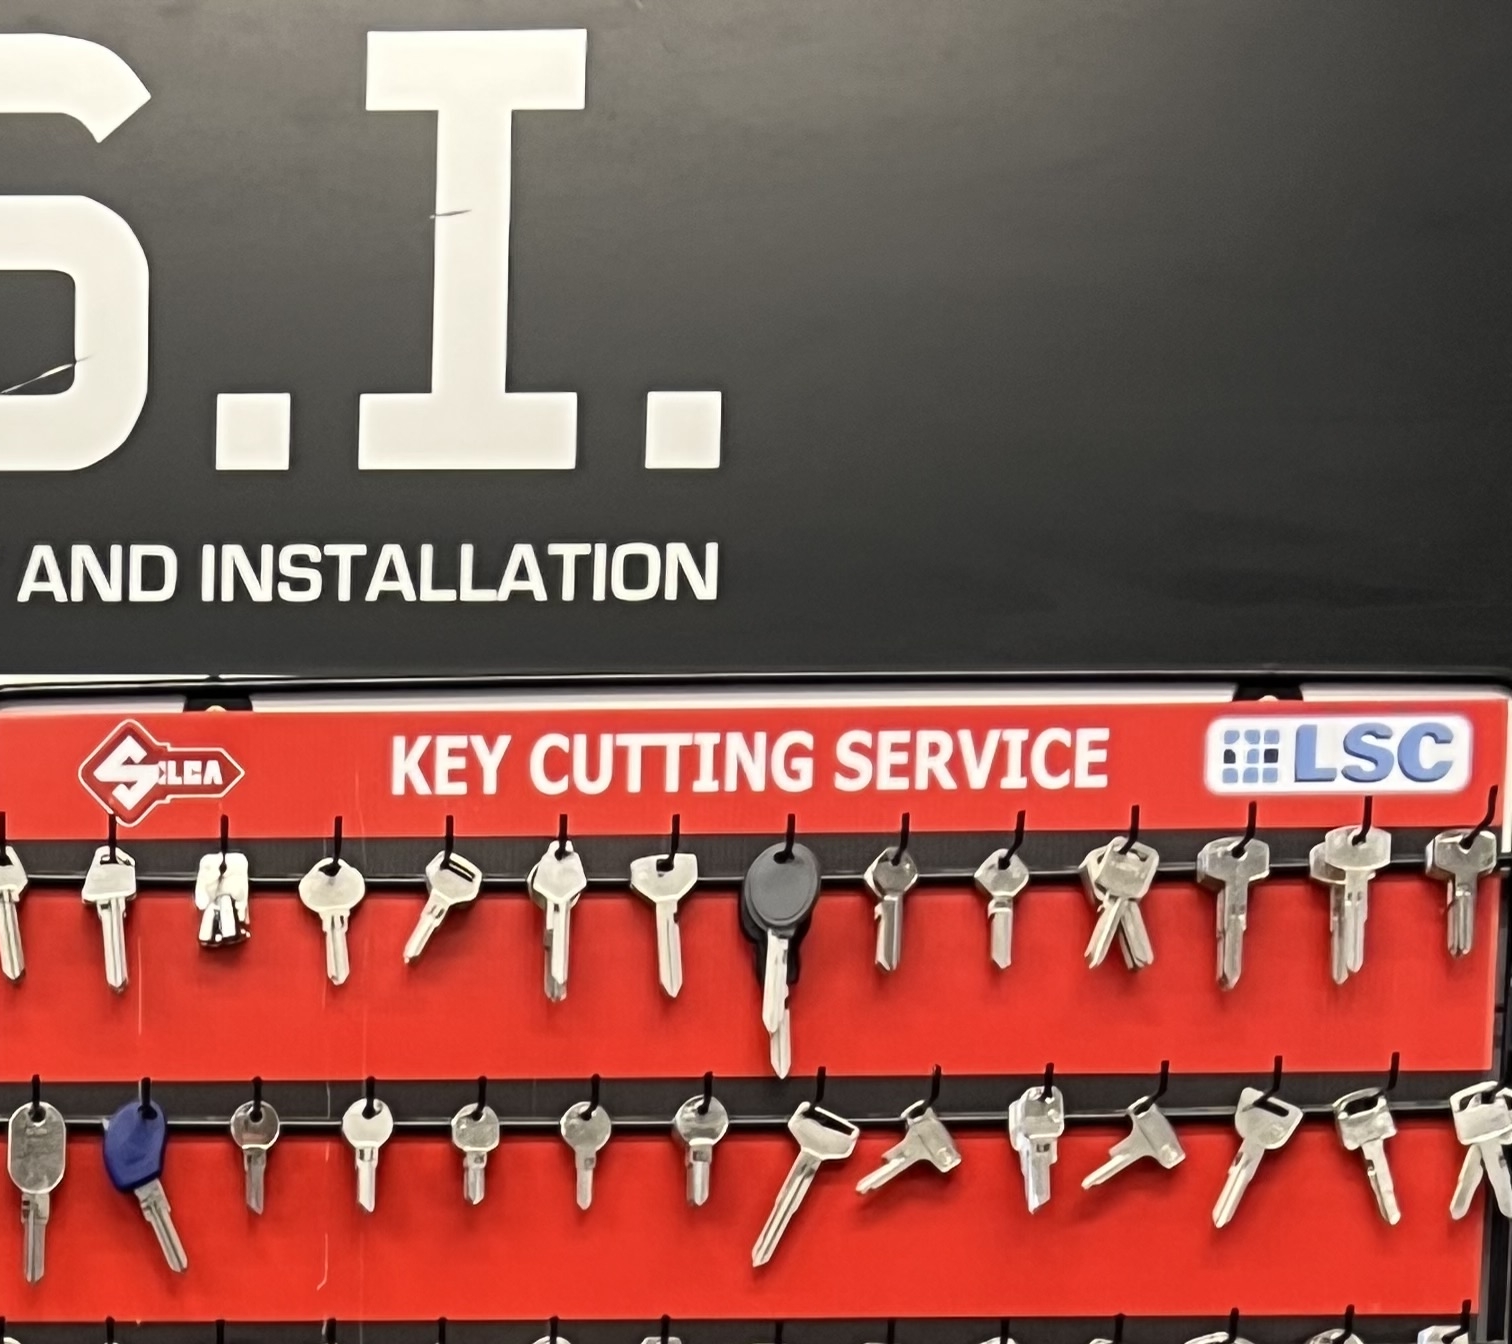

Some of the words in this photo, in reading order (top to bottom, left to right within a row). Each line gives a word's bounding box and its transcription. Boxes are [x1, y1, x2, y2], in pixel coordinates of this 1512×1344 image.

[16, 543, 178, 603] AND
[200, 541, 719, 603] INSTALLATION
[391, 733, 512, 796] KEY
[529, 730, 814, 795] CUTTING
[834, 727, 1110, 793] SERVICE
[1294, 722, 1454, 783] LSC
